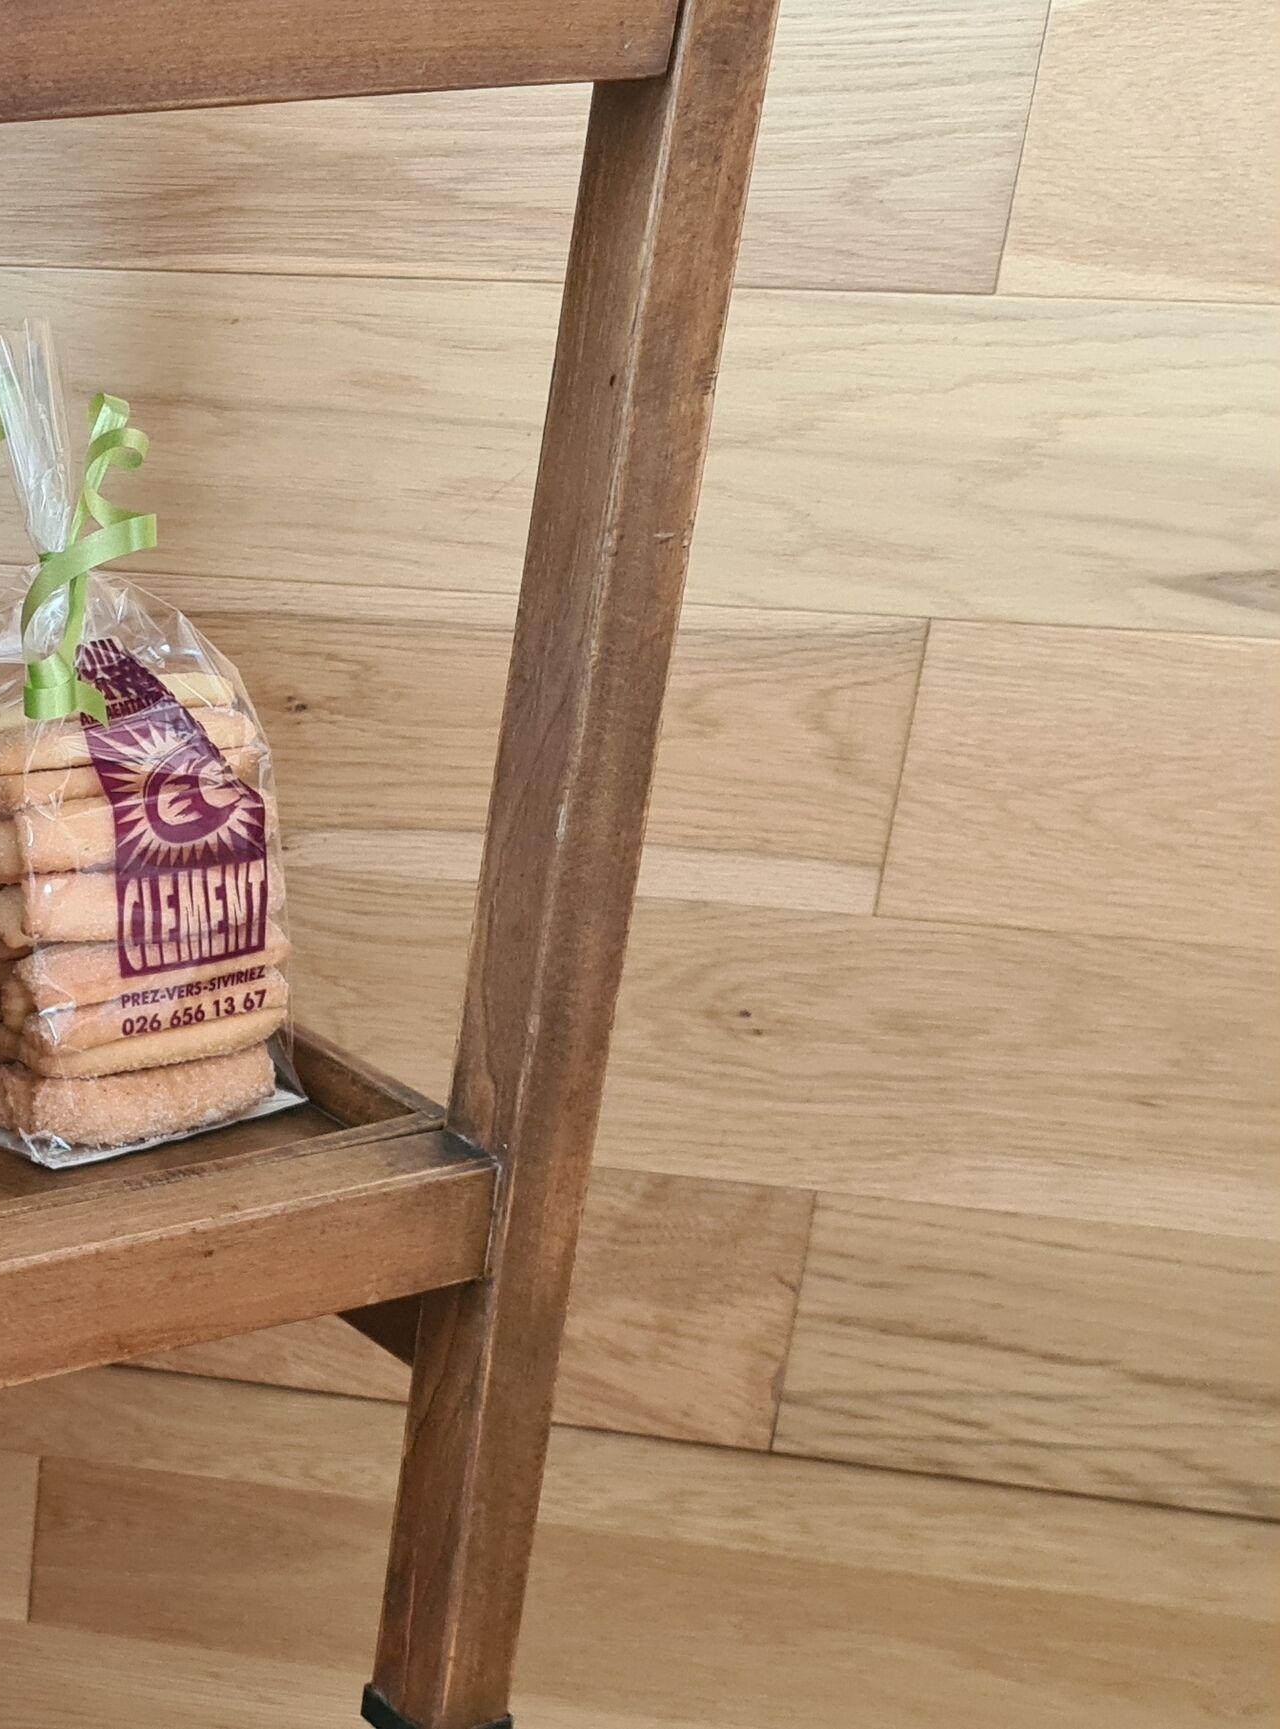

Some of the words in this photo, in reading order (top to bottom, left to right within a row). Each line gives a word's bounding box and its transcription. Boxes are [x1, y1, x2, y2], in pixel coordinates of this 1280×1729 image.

[124, 859, 265, 971] CLEMENT
[121, 965, 266, 1009] PREZ-VERS-SIVIRIEZ
[122, 1009, 162, 1036] 026
[169, 1001, 205, 1028] 656
[213, 995, 235, 1017] 13
[243, 989, 267, 1011] 67
